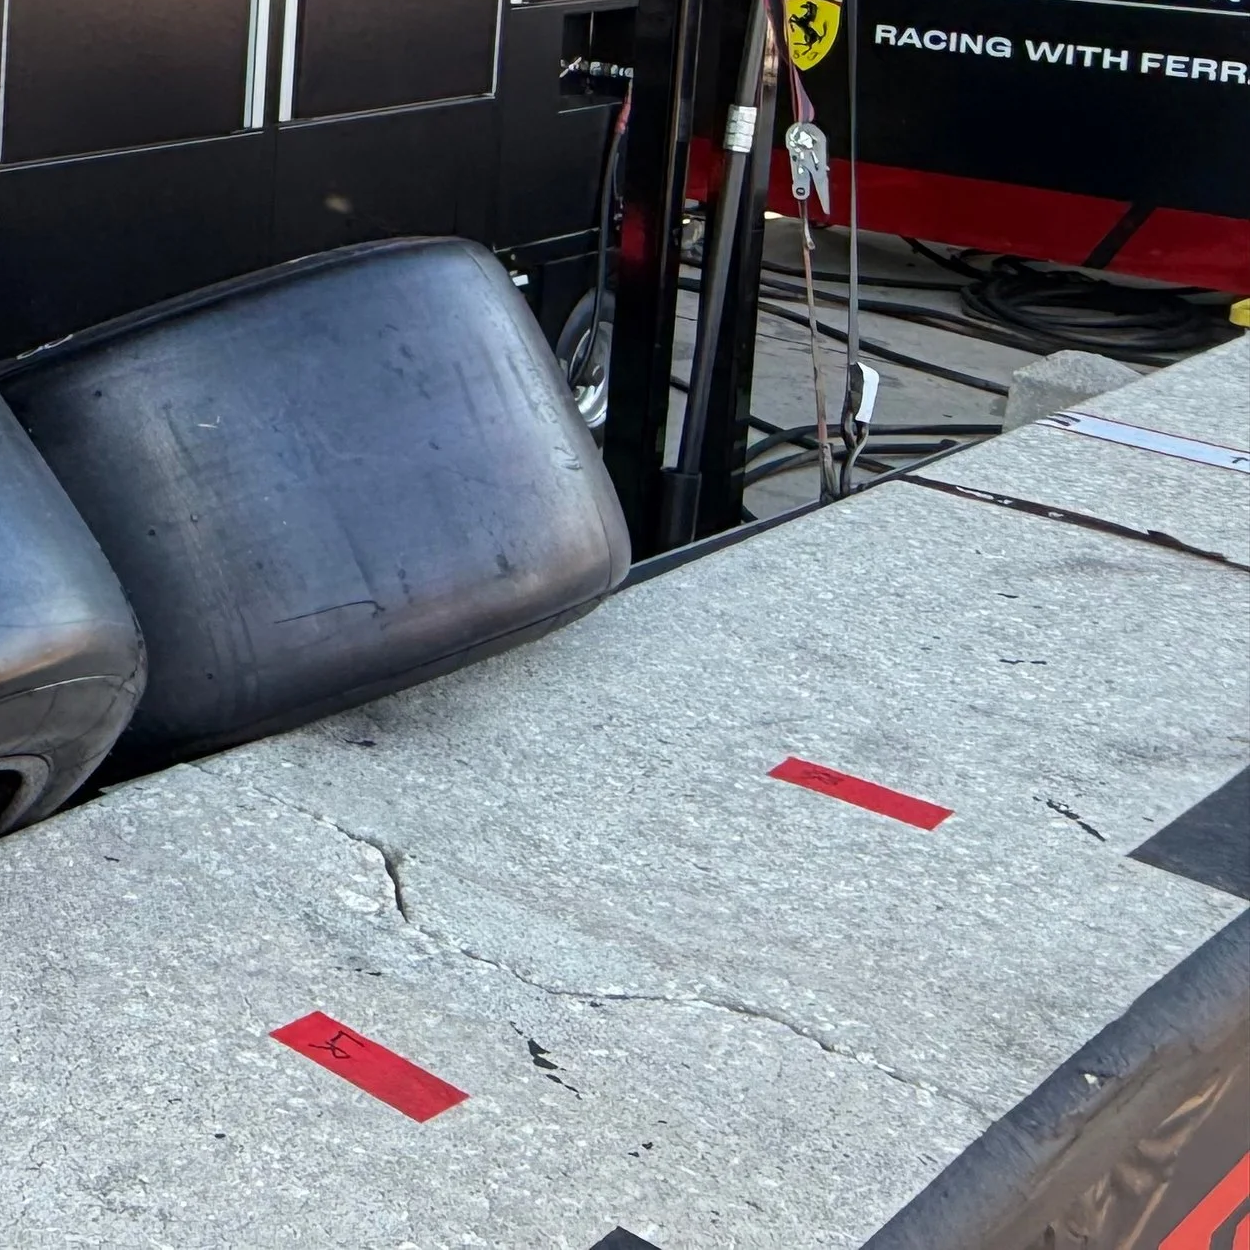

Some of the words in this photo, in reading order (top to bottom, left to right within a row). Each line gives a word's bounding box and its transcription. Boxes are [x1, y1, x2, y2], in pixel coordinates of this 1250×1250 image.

[874, 23, 1012, 59] RACING
[1025, 39, 1128, 72] WITH
[1140, 52, 1250, 86] FERR
